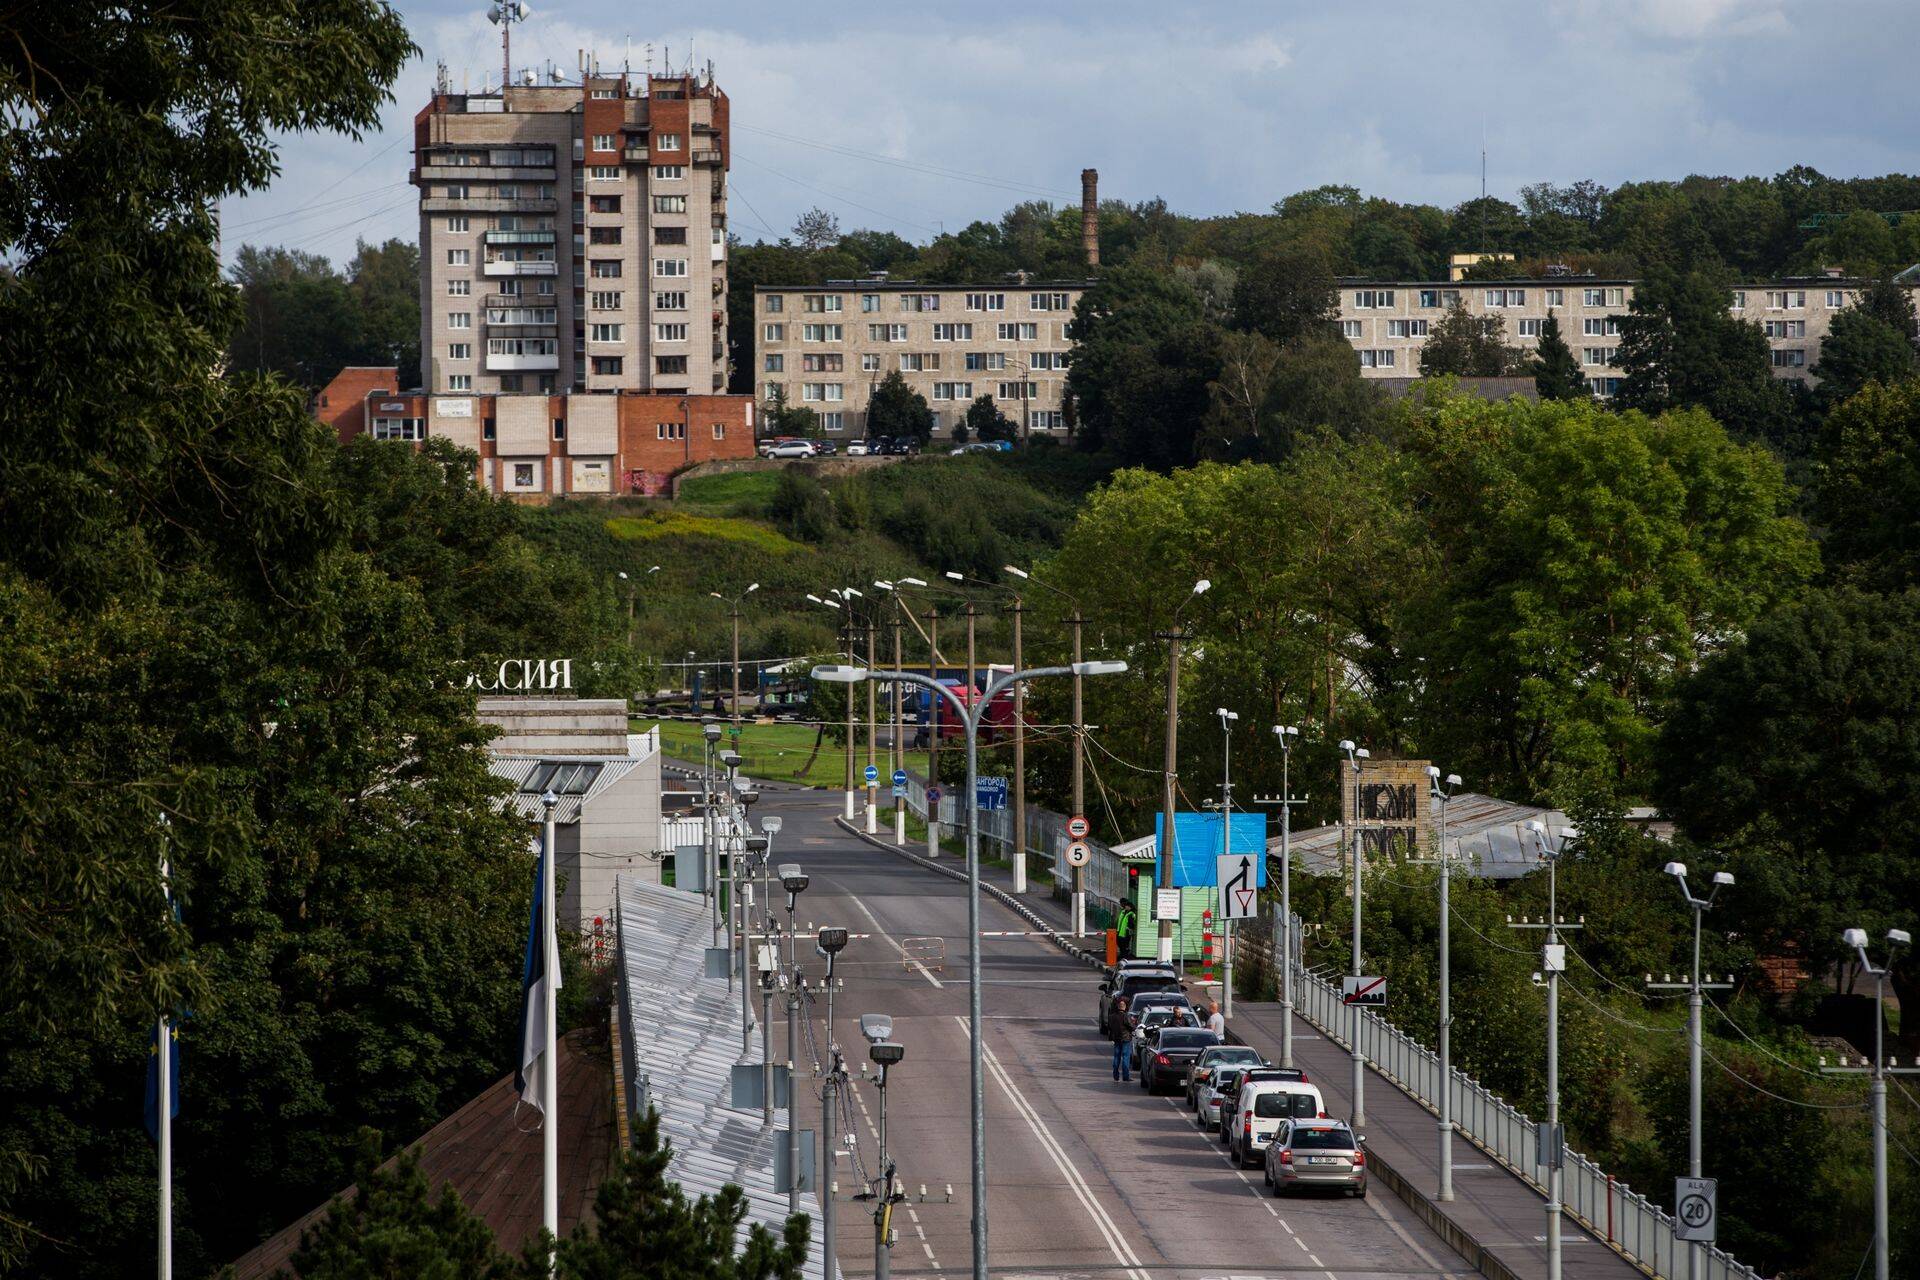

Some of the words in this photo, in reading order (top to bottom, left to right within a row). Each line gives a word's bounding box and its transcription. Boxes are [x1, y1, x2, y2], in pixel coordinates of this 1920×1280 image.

[976, 777, 1005, 788] АНГОРОД
[1074, 848, 1083, 861] 5
[1688, 1182, 1705, 1190] ALA
[1686, 1203, 1704, 1219] 20
